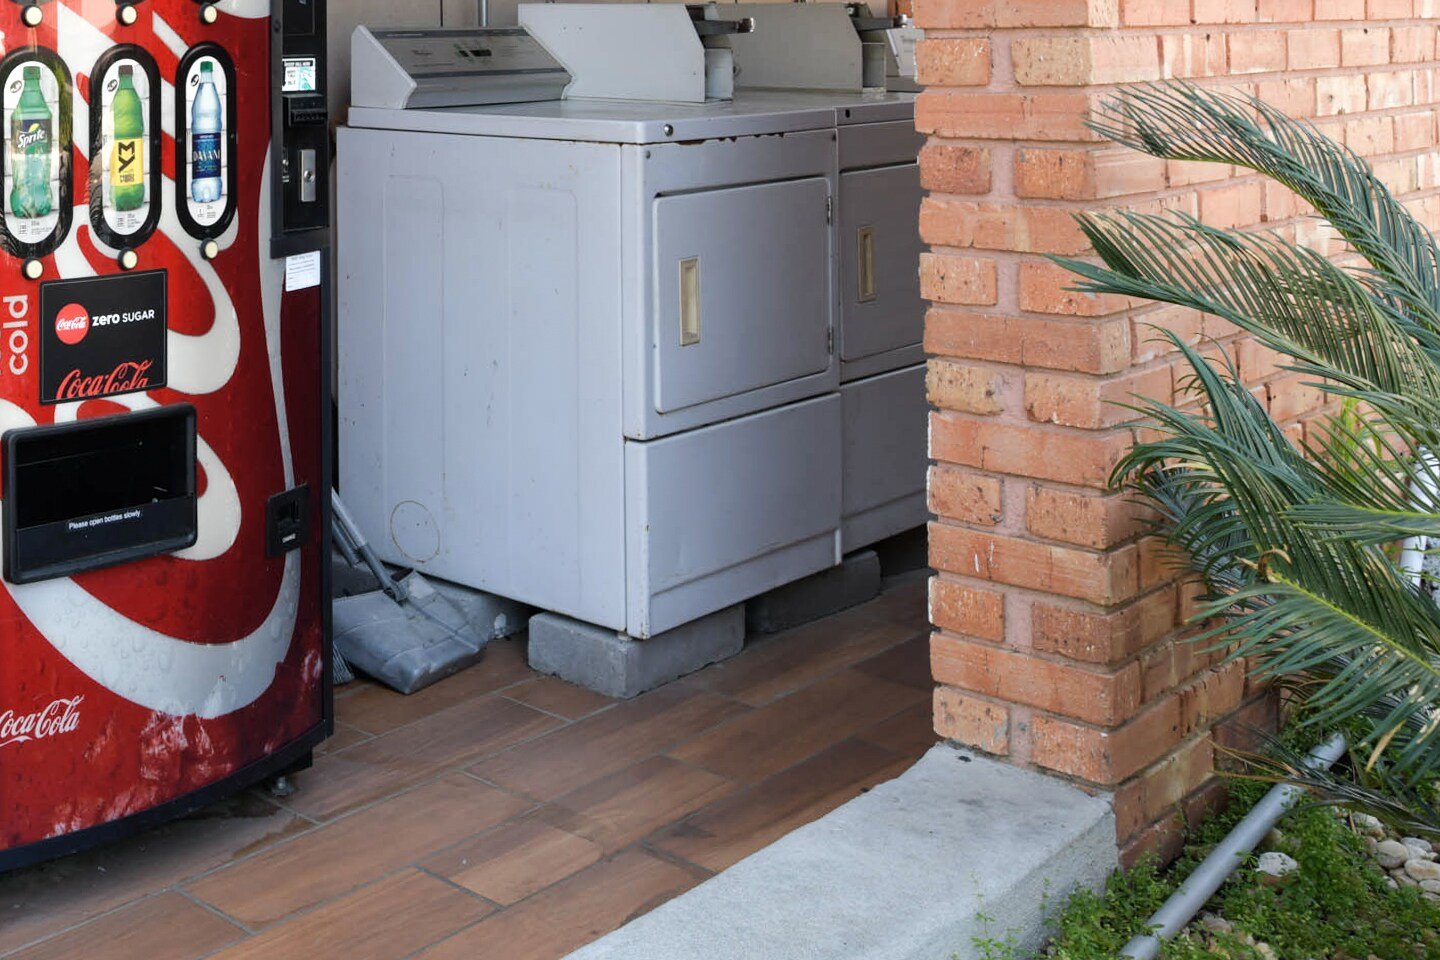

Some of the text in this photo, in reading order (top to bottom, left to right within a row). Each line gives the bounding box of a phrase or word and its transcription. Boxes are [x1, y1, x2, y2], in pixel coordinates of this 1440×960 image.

[17, 130, 46, 148] Sprite
[92, 312, 121, 327] zero
[122, 309, 155, 324] SUGAR
[3, 294, 29, 376] cold
[68, 509, 141, 530] Please open bottles slowly
